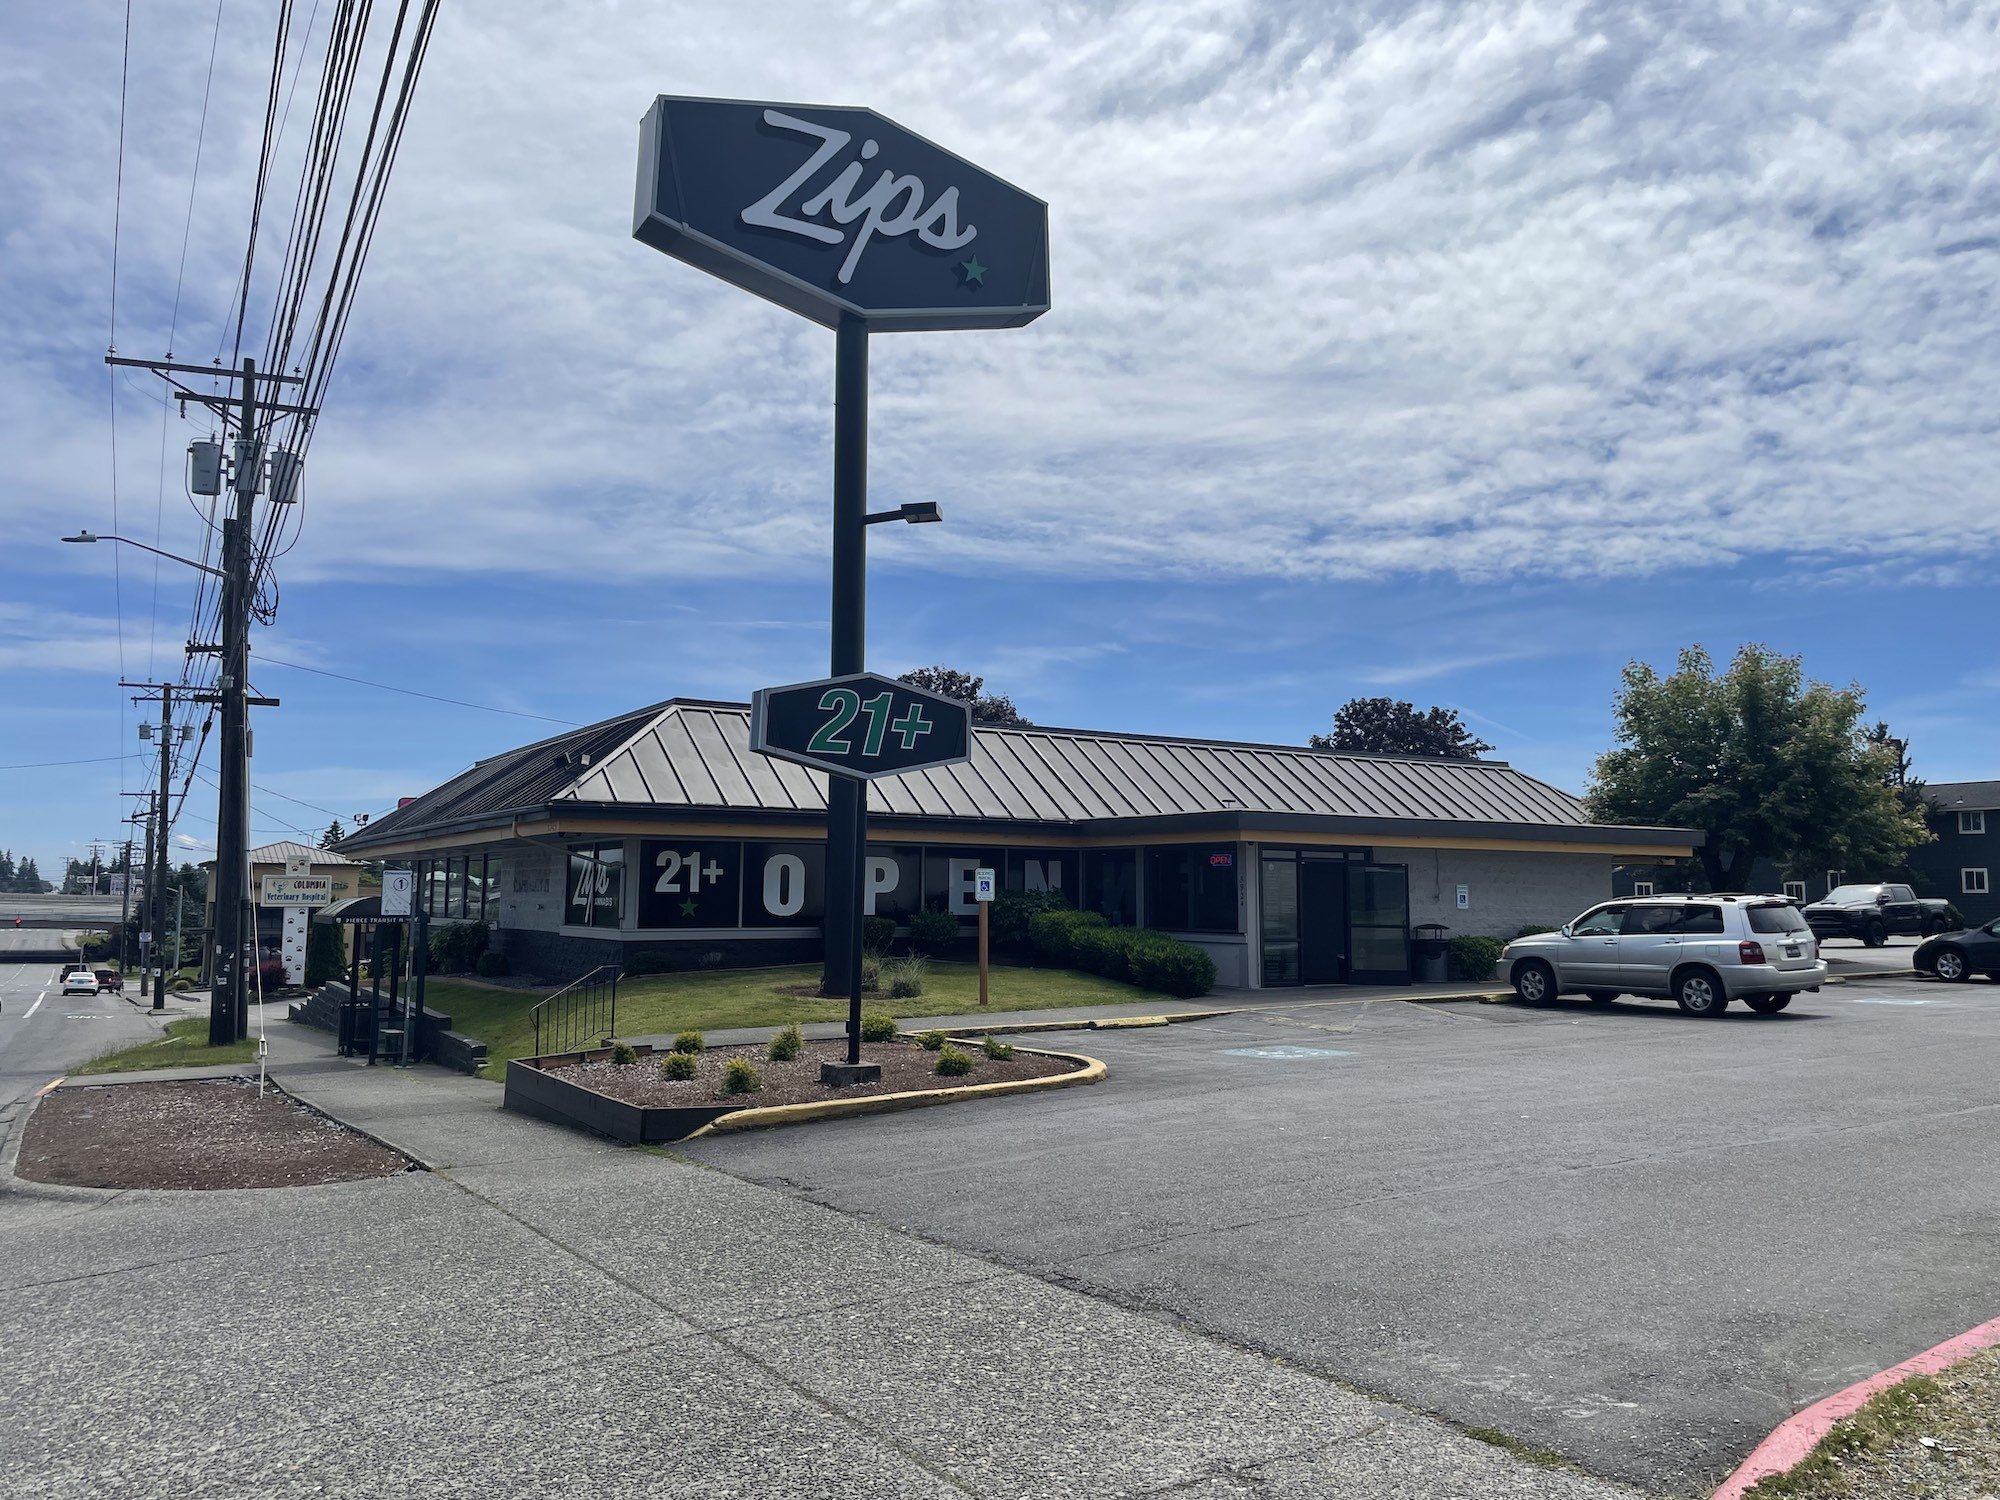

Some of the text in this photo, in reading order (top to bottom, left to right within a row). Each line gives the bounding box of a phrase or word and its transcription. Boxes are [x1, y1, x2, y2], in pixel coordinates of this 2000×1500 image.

[741, 108, 977, 284] Zips
[806, 687, 933, 757] 21+
[1210, 856, 1231, 865] OPEN
[655, 850, 724, 893] 21+
[293, 880, 326, 889] COLUMBIA
[398, 879, 404, 889] 1
[267, 893, 326, 901] Veterinary Hospital
